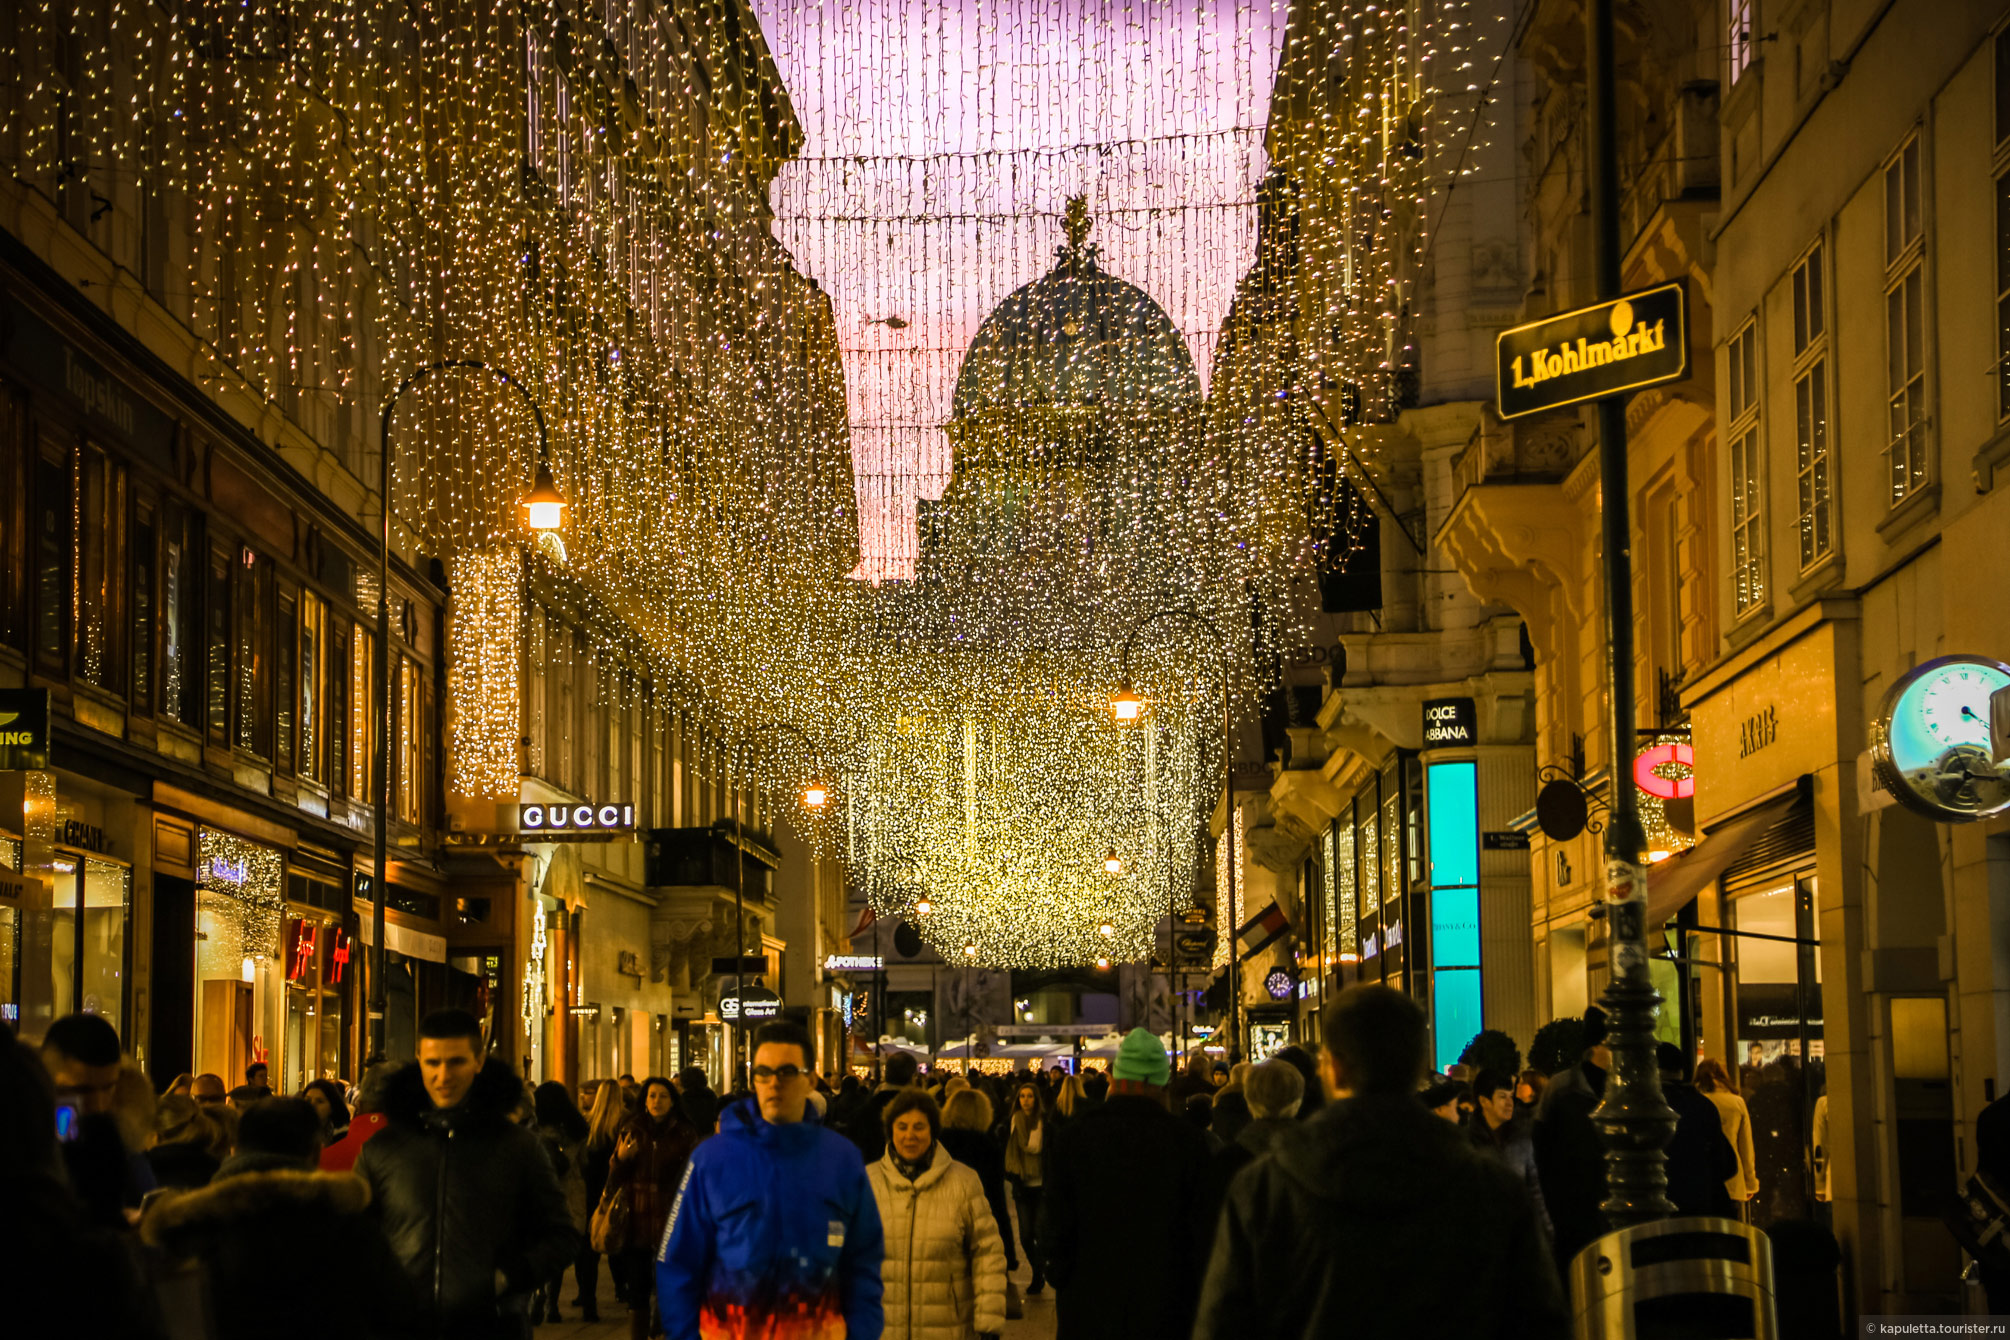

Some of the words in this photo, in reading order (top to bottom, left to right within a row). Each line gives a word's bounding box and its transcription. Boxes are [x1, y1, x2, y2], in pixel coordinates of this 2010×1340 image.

[1426, 706, 1456, 720] DOLCE
[1740, 704, 1779, 759] AKRIS
[523, 806, 631, 827] GUCCI
[824, 954, 883, 969] APOTHEKE
